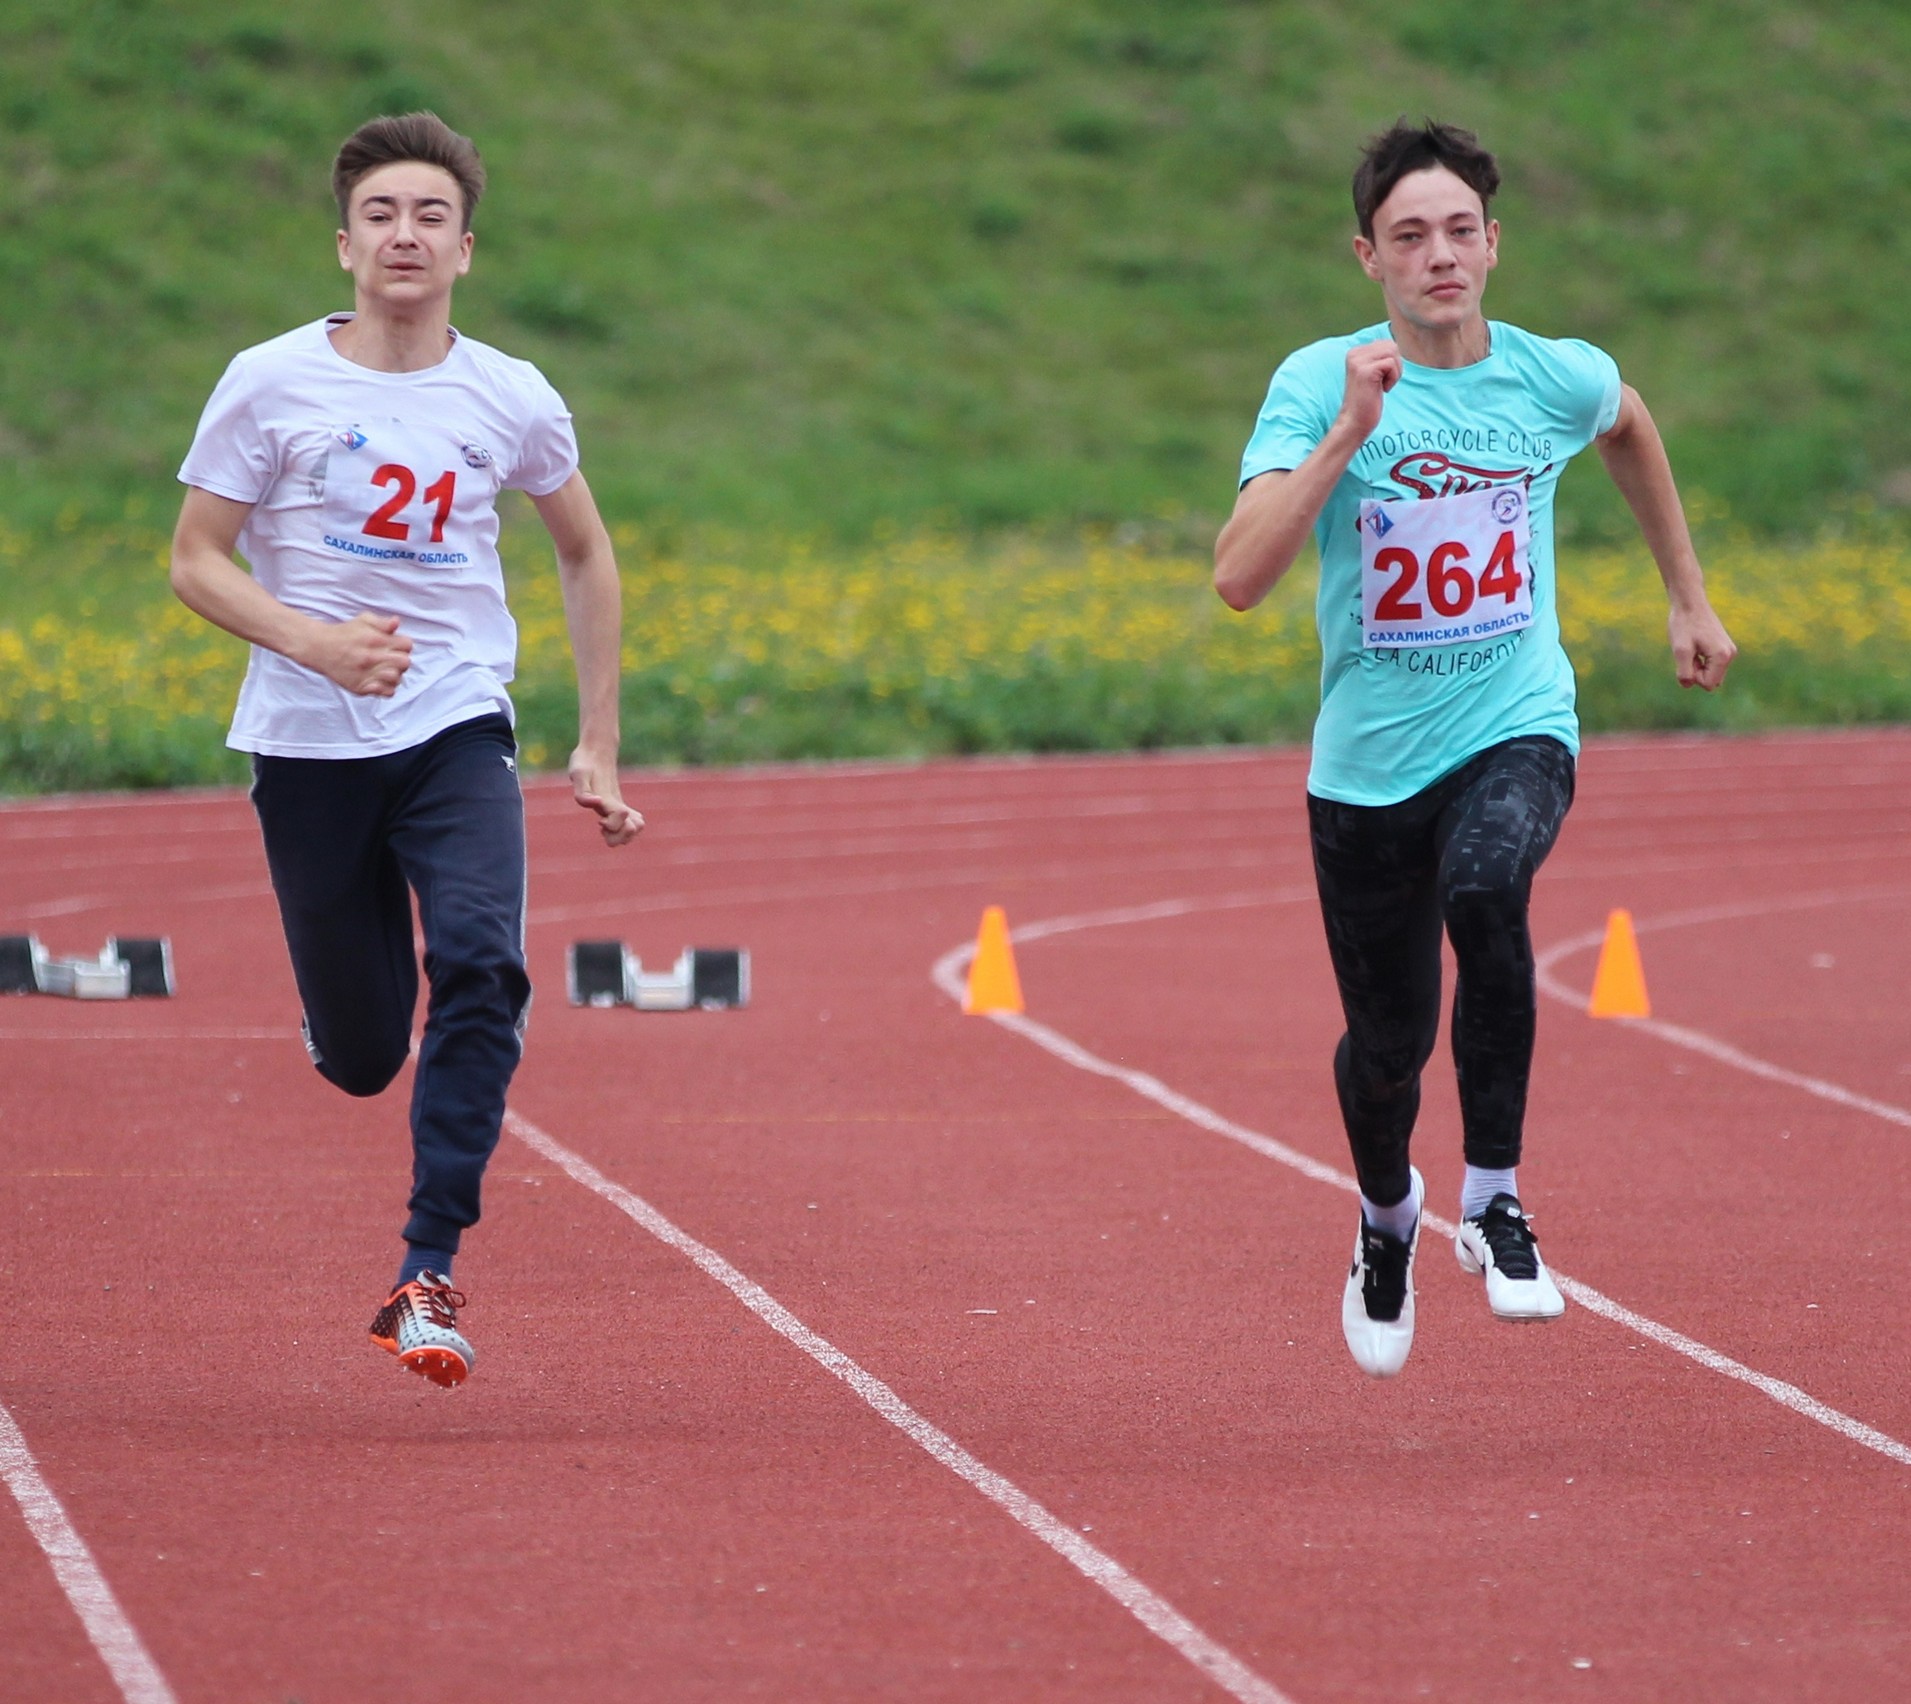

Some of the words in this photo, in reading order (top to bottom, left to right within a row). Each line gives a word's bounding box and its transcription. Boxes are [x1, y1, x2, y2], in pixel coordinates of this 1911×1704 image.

[1360, 429, 1498, 466] MOTORCYCLE
[1507, 431, 1553, 461] CLUB
[361, 463, 457, 543] 21
[323, 535, 416, 560] САХАЛИНСКАЯ
[418, 552, 468, 564] ОБЛАСТЬ
[1373, 530, 1523, 621] 264
[1369, 626, 1470, 643] САХАЛИНСКАЯ
[1475, 612, 1530, 635] ОБЛАСТЬ
